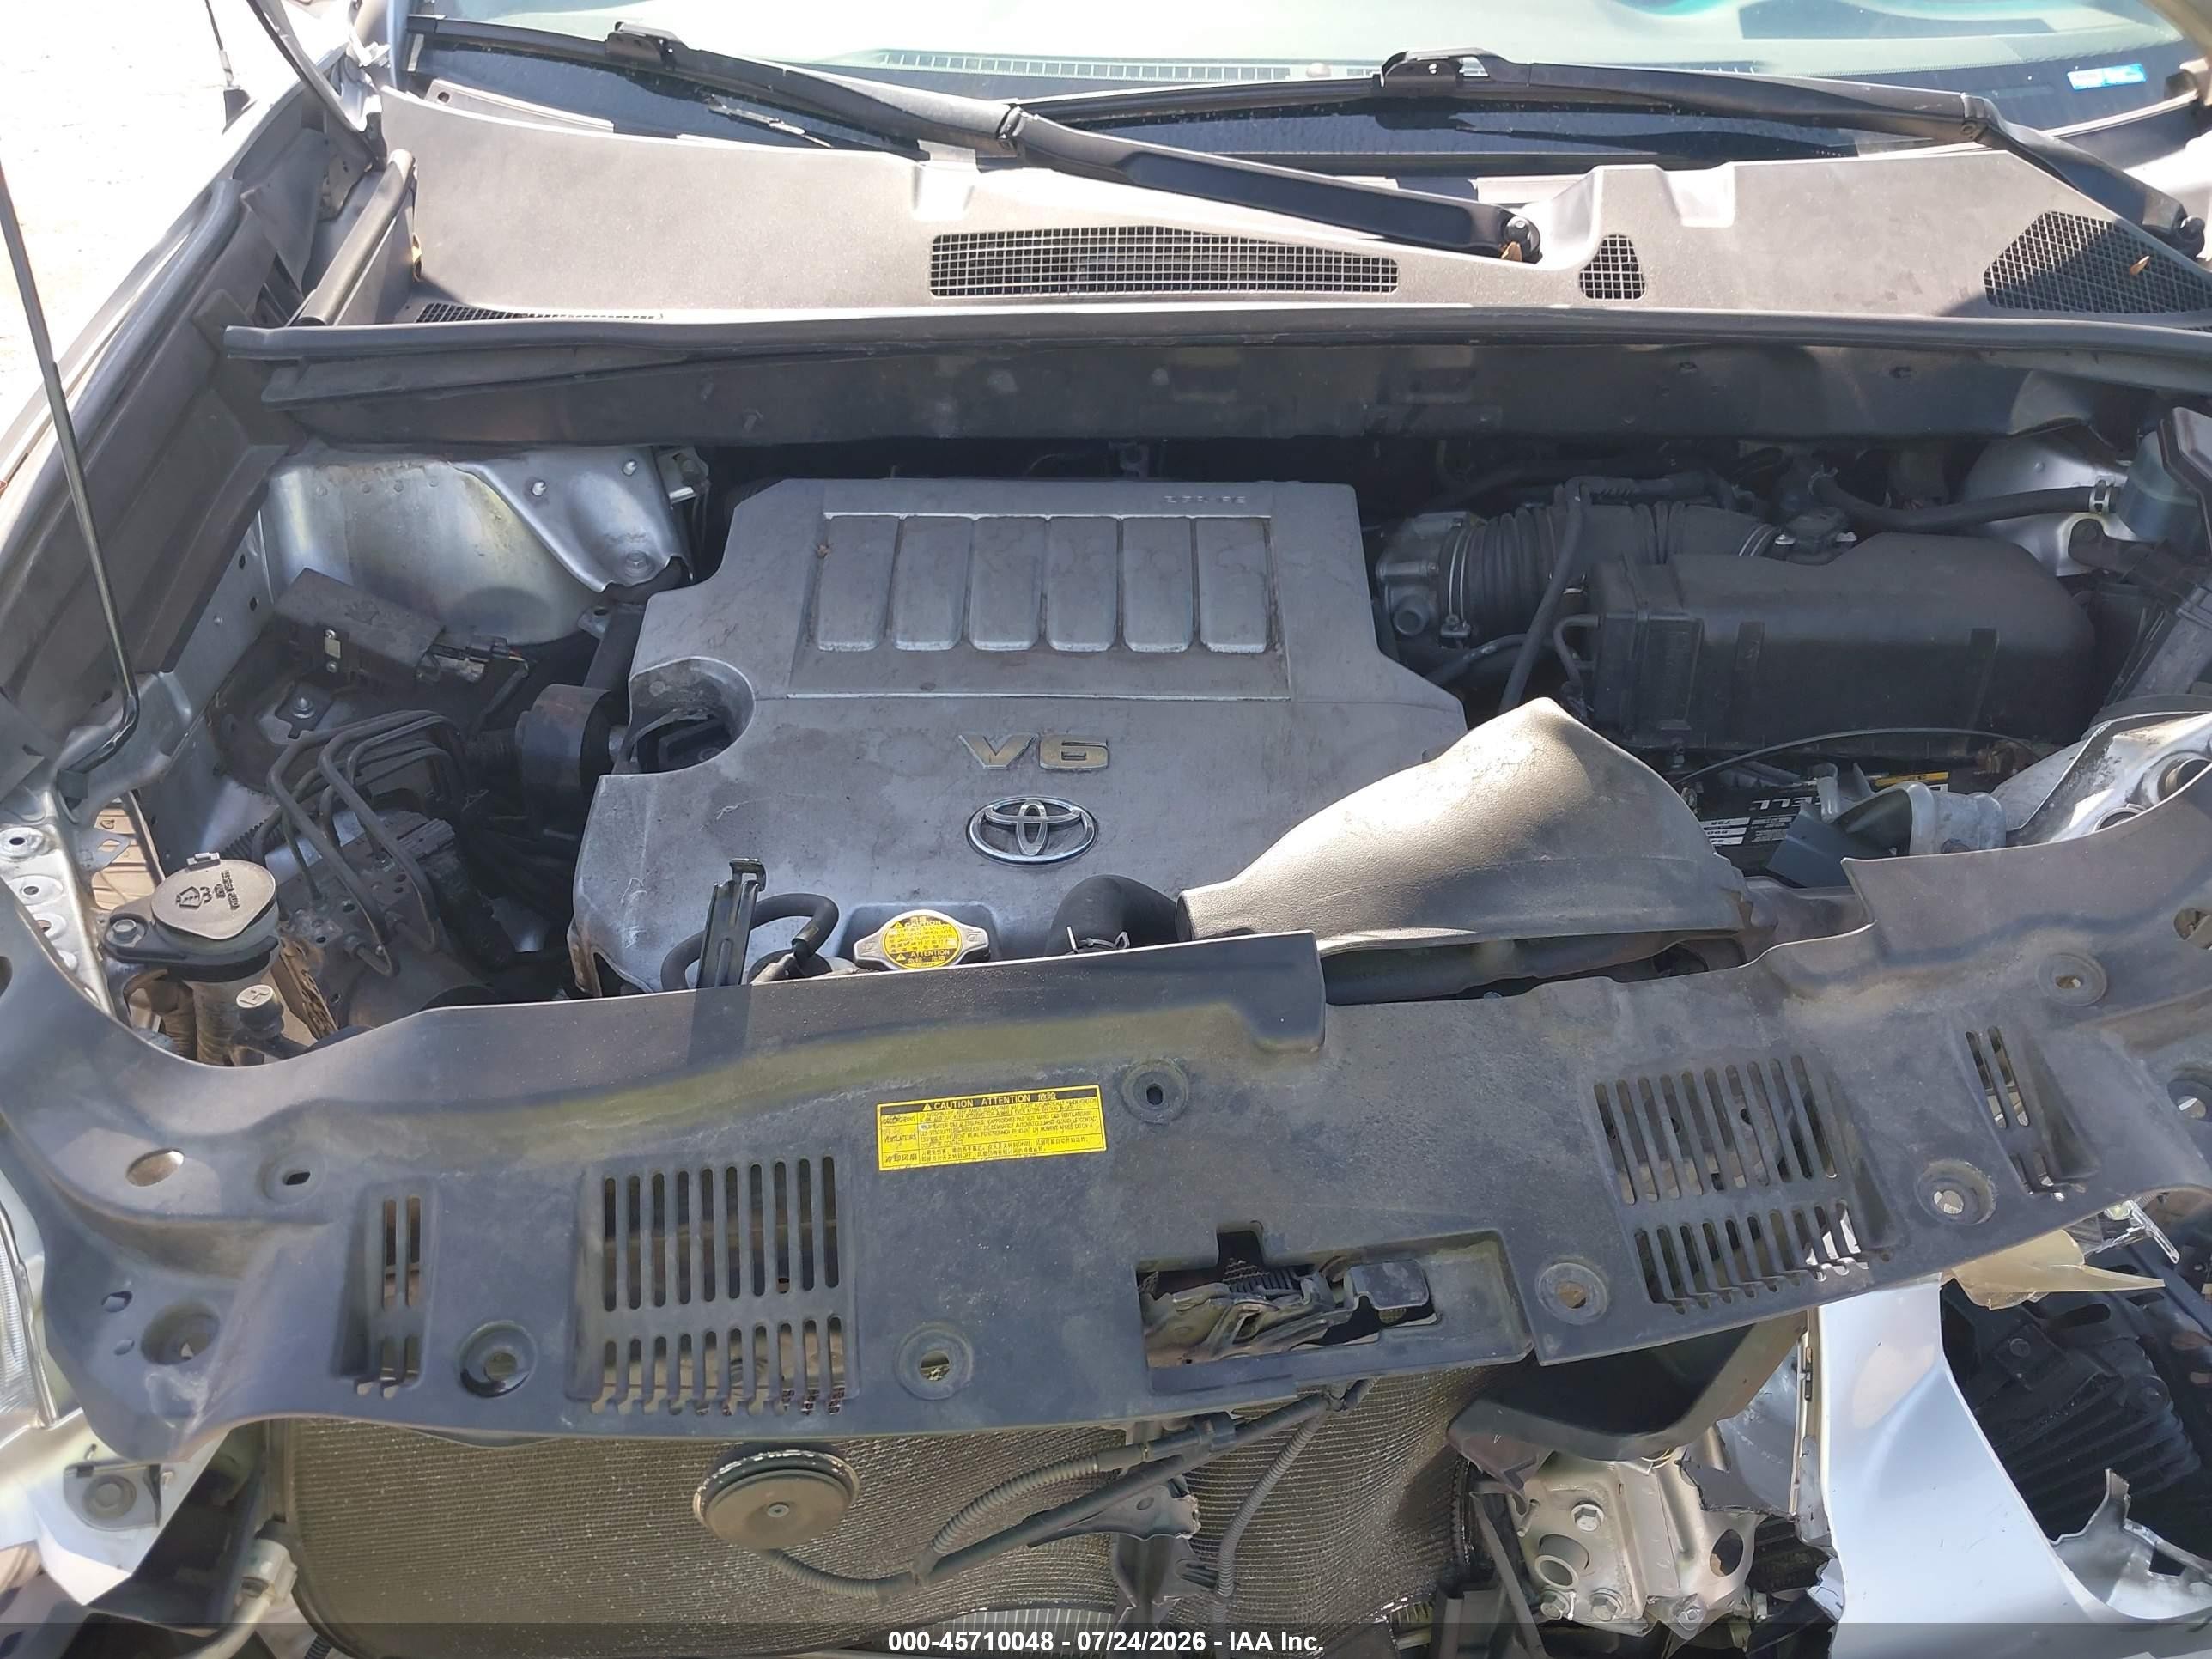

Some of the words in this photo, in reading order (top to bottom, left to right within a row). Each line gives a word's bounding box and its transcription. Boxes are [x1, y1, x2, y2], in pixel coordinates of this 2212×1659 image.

[958, 734, 1110, 770] V6
[934, 1098, 973, 1110] CAUTION
[981, 1095, 1030, 1106] ATTENTION
